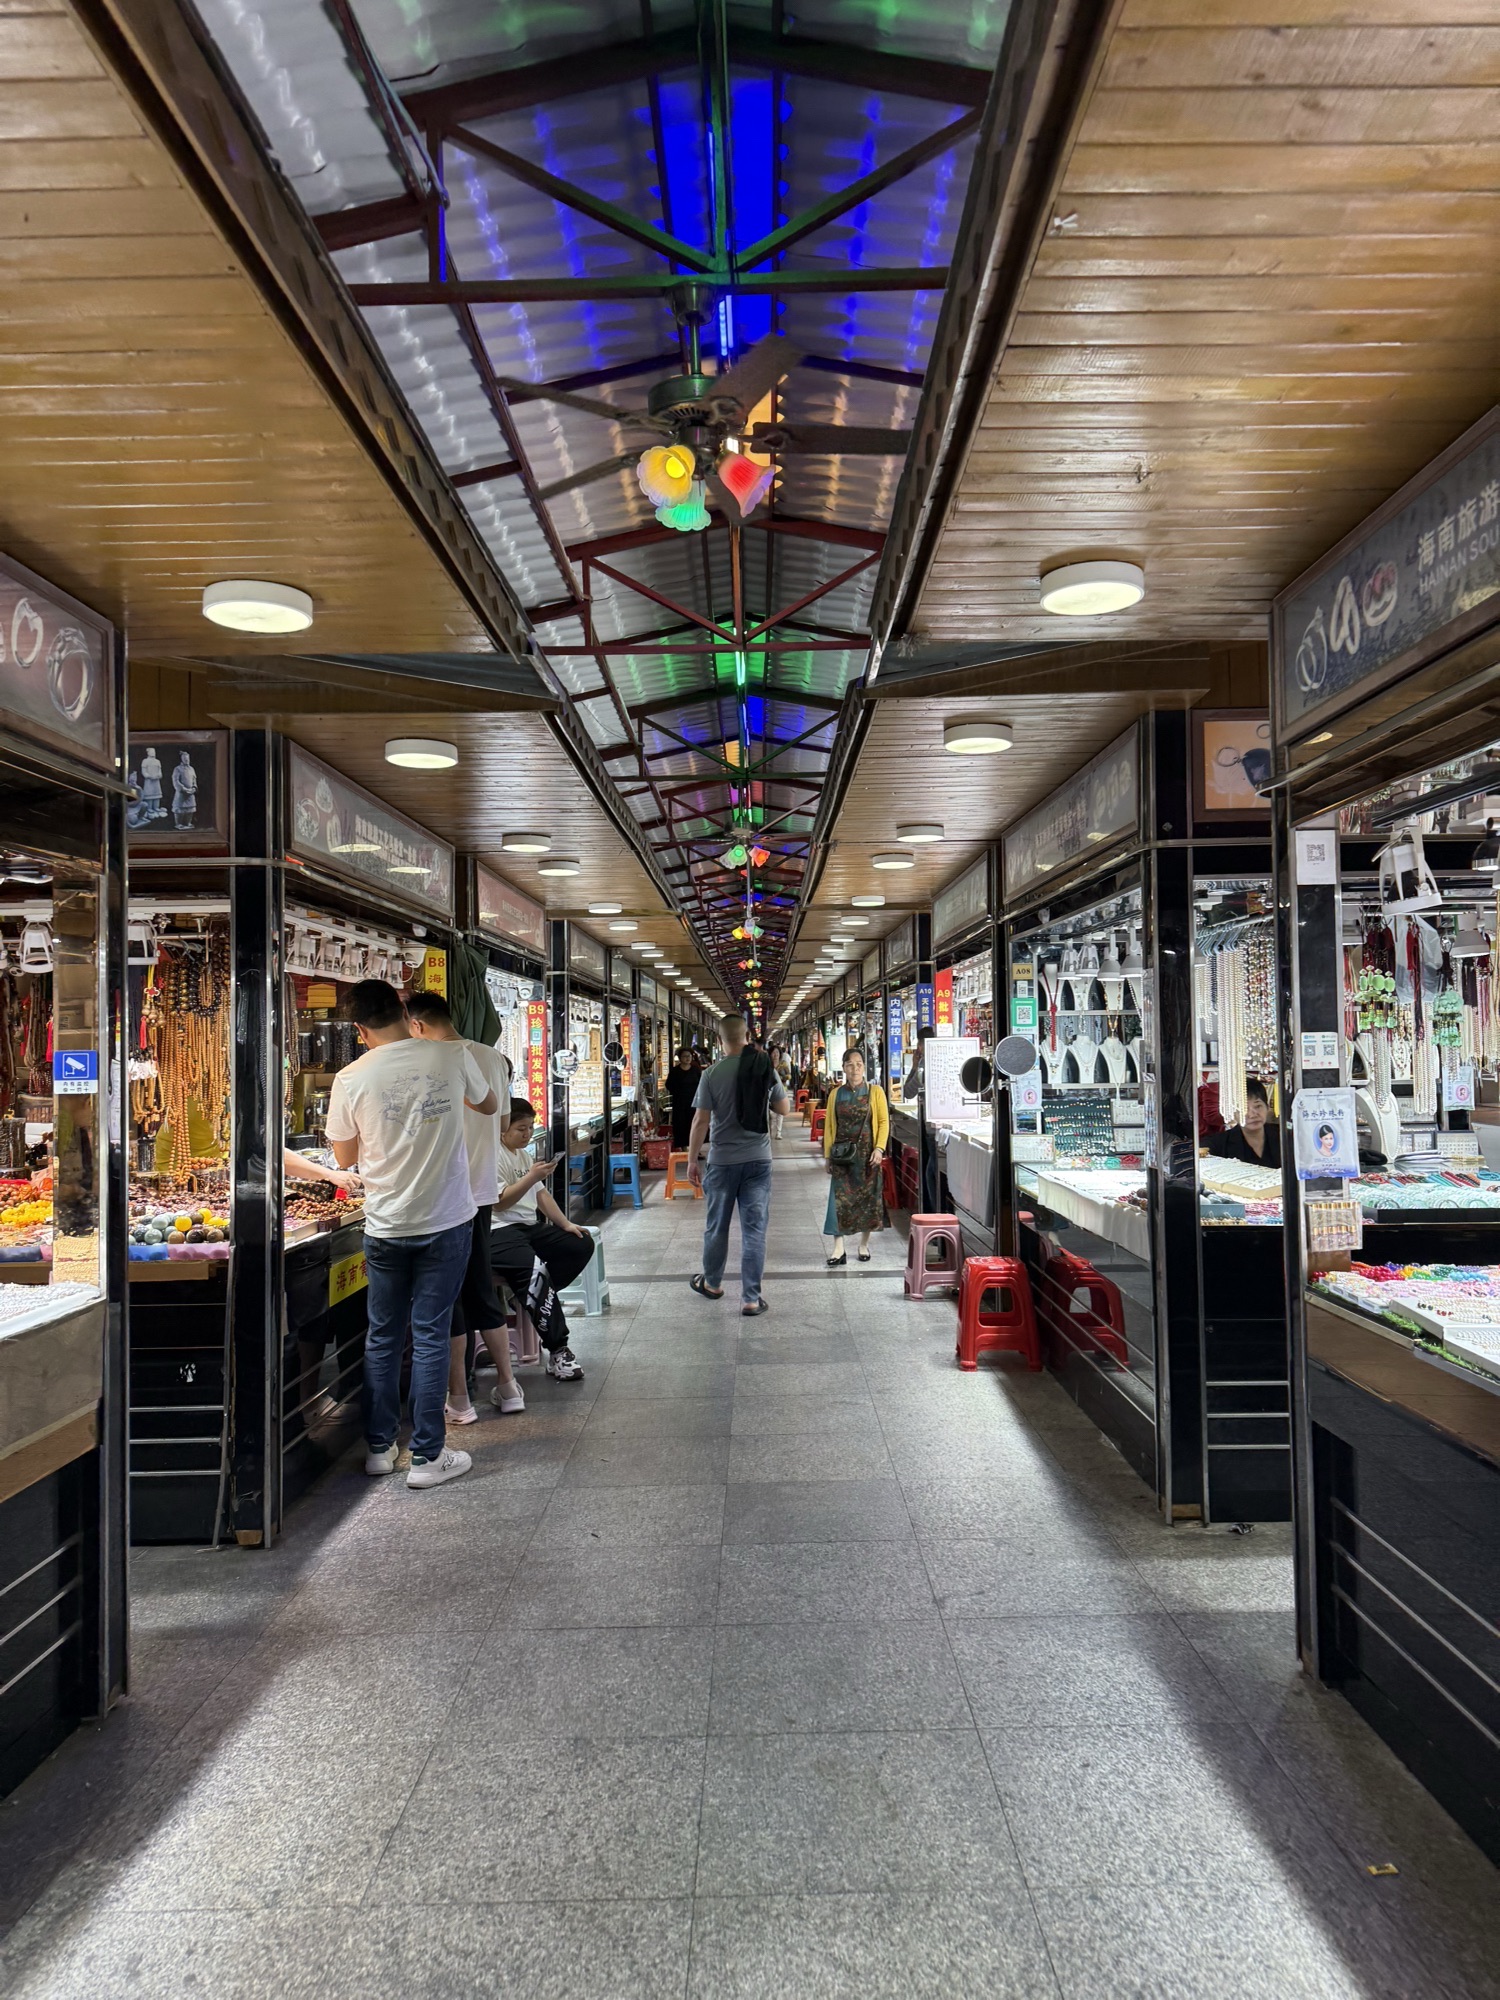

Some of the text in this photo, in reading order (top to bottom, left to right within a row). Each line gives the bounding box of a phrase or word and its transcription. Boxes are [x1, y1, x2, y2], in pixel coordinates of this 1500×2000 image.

[1417, 479, 1500, 572] 海南旅游
[1419, 523, 1500, 596] HAINAN SOU
[428, 957, 445, 968] B8
[936, 989, 951, 998] A9
[528, 1005, 545, 1015] B9
[938, 1001, 949, 1024] 批发
[530, 1017, 544, 1124] 珍批发海水淡水
